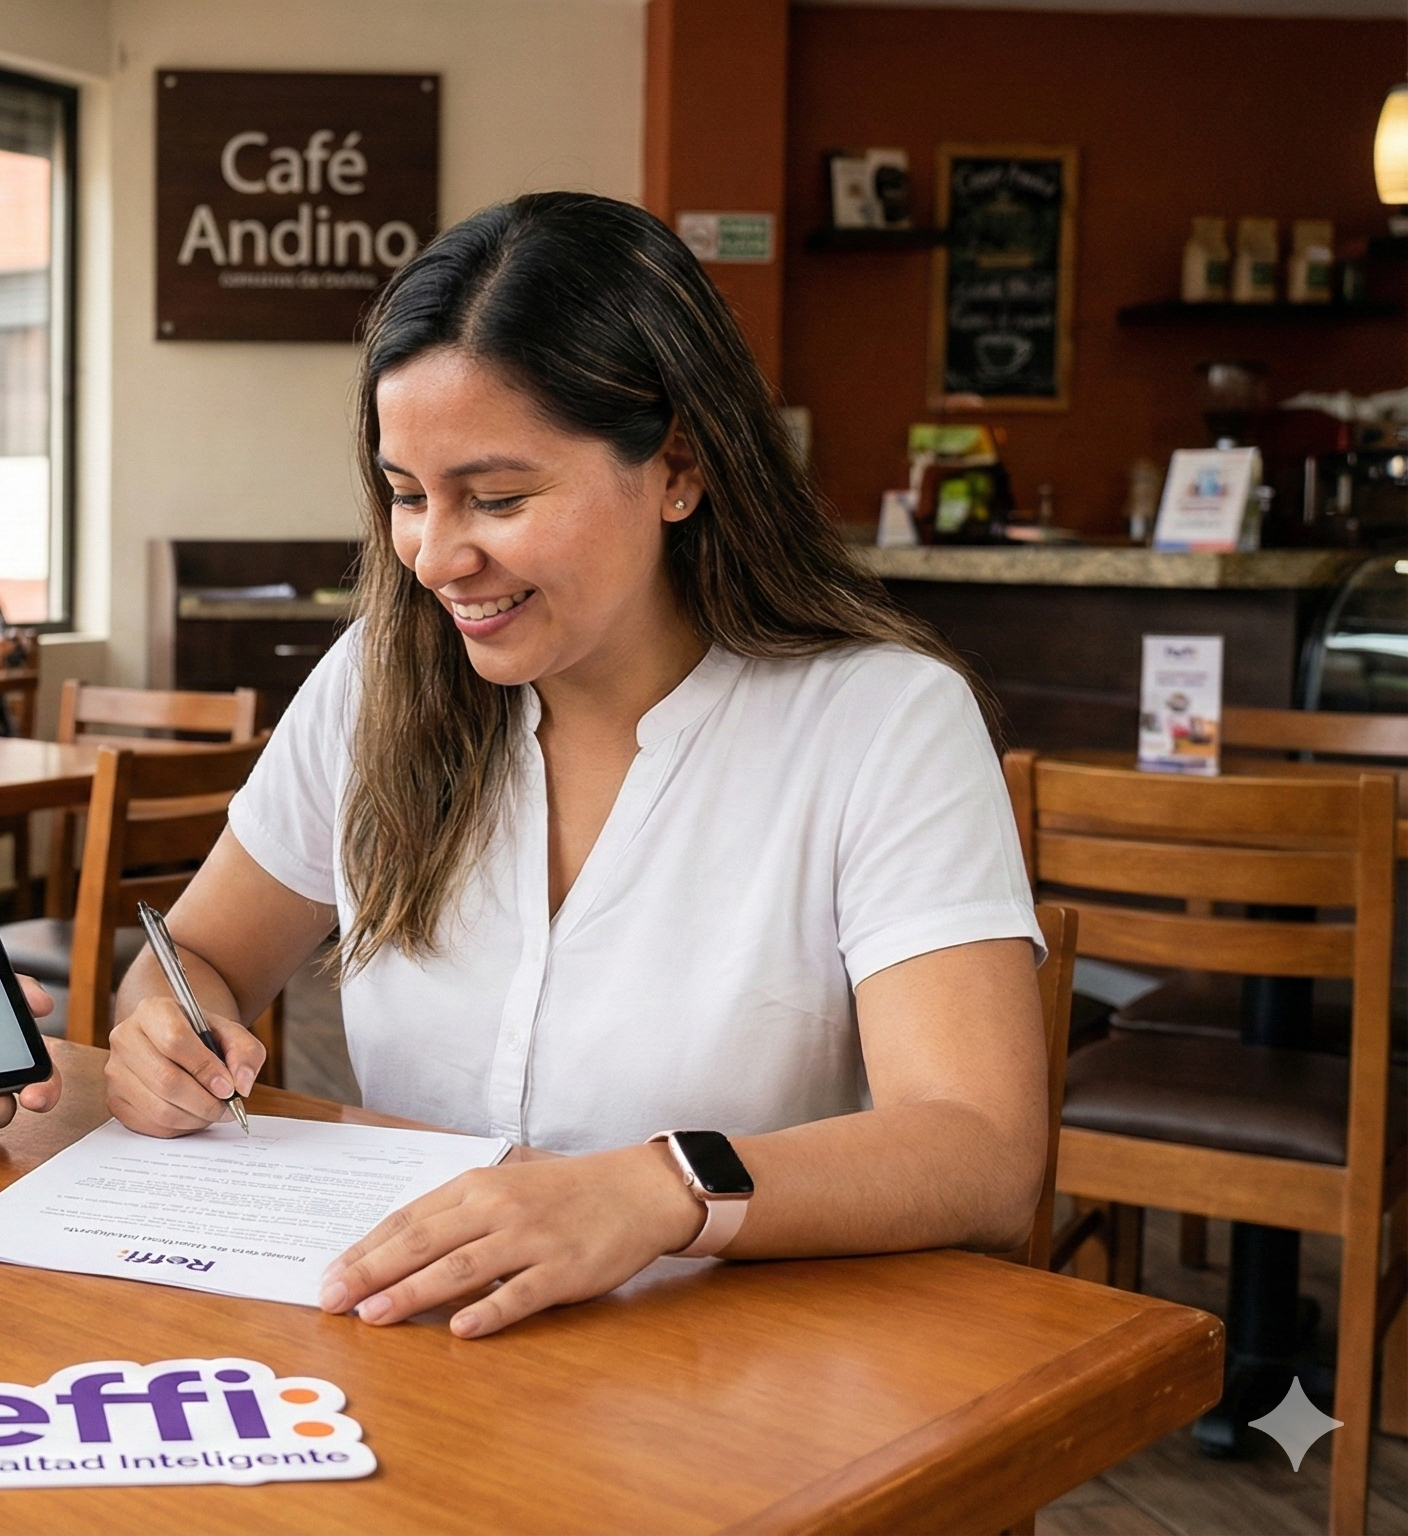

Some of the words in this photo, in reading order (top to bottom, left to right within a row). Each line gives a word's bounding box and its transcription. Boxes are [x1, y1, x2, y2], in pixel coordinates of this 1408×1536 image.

[221, 129, 368, 195] Café
[177, 203, 418, 267] Andino
[120, 1449, 351, 1470] Inteligente
